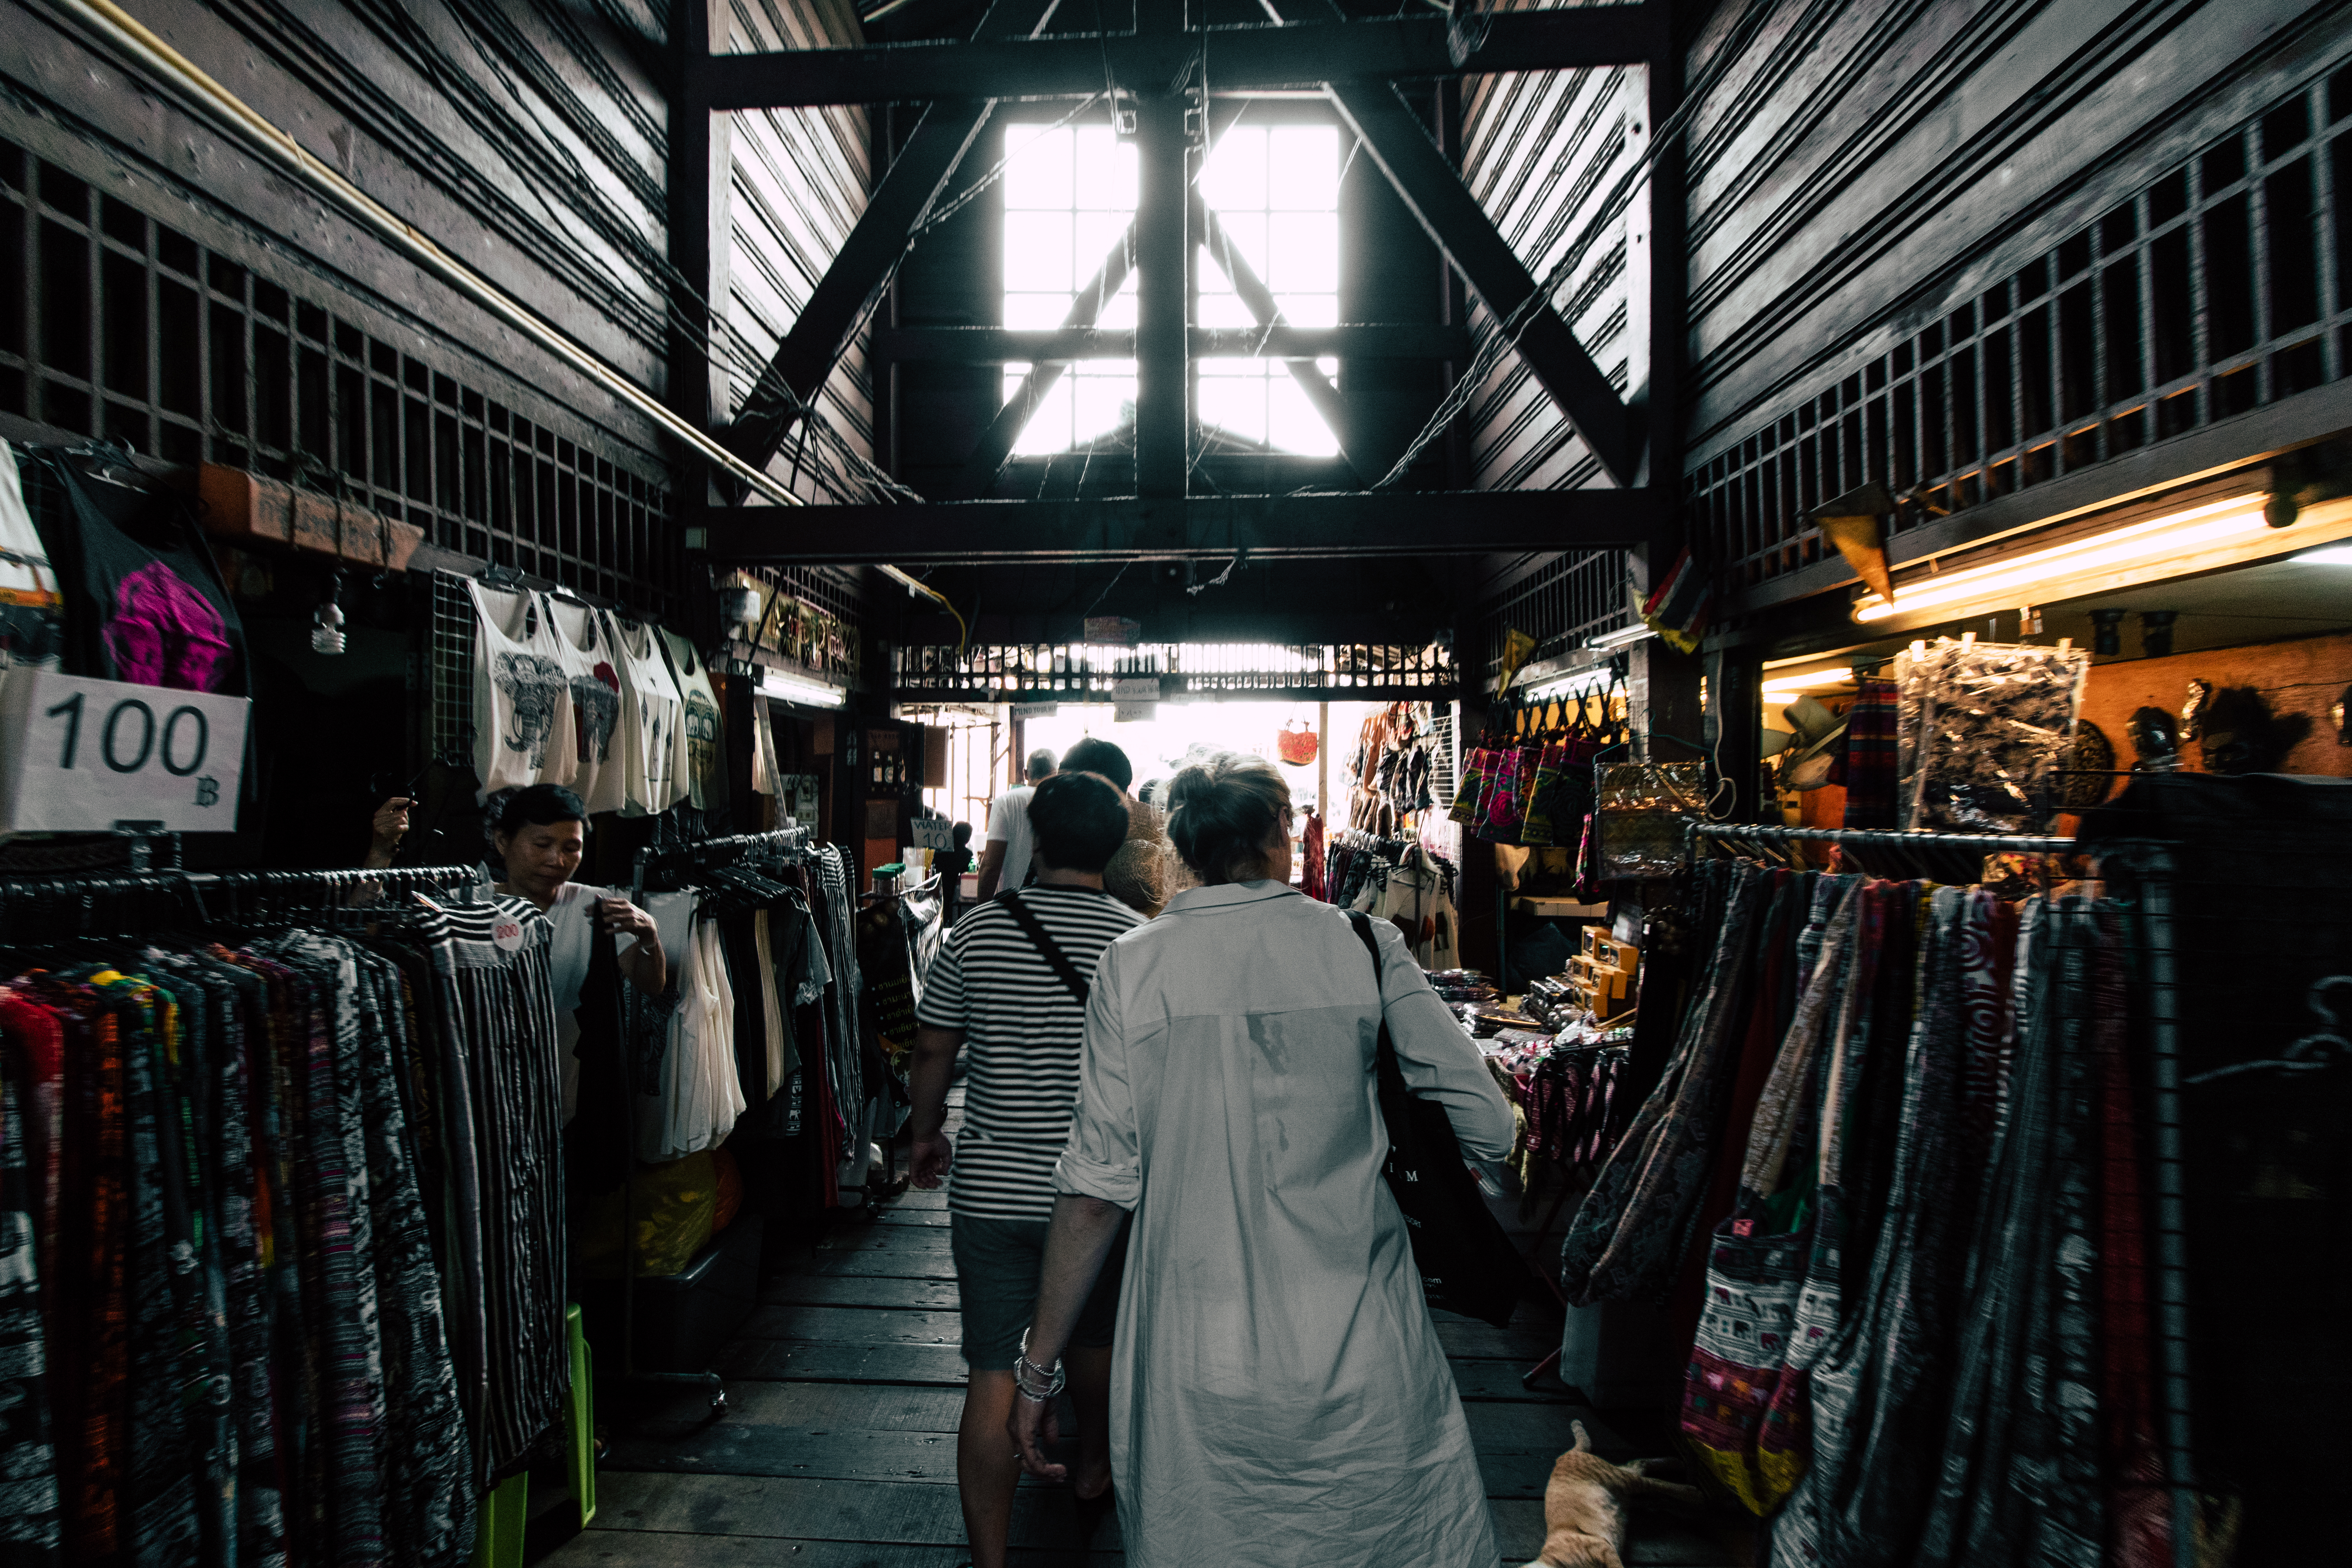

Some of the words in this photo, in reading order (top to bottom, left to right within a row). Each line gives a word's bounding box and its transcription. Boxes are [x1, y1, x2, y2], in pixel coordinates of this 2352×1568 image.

[1014, 707, 1033, 716] MIND
[1033, 706, 1048, 714] YOUR
[47, 691, 209, 777] 100
[496, 923, 519, 939] 200
[882, 990, 912, 1005] ชามะนา
[887, 1004, 914, 1020] ชาดำเย็
